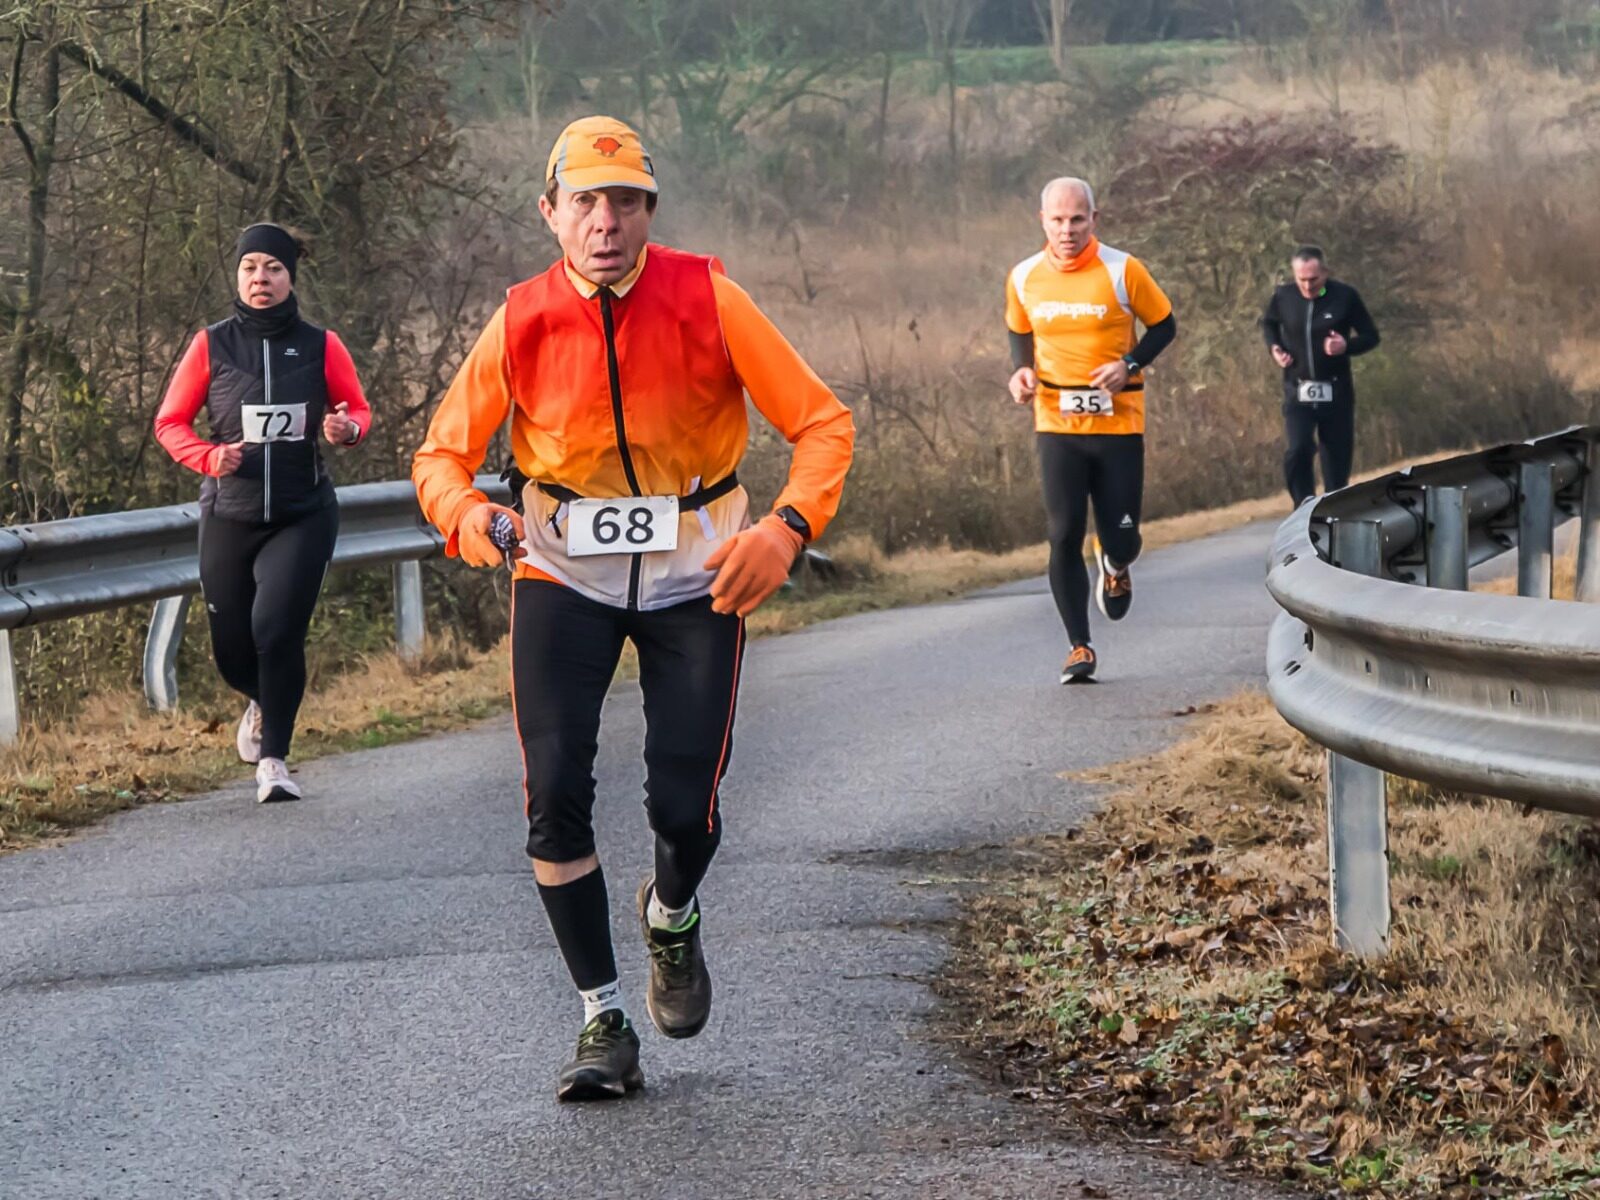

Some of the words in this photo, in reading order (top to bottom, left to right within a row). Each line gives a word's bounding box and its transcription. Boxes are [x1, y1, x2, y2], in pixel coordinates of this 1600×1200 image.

[1307, 385, 1325, 399] 61
[1072, 395, 1101, 414] 35
[256, 411, 293, 437] 72
[592, 506, 654, 545] 68
